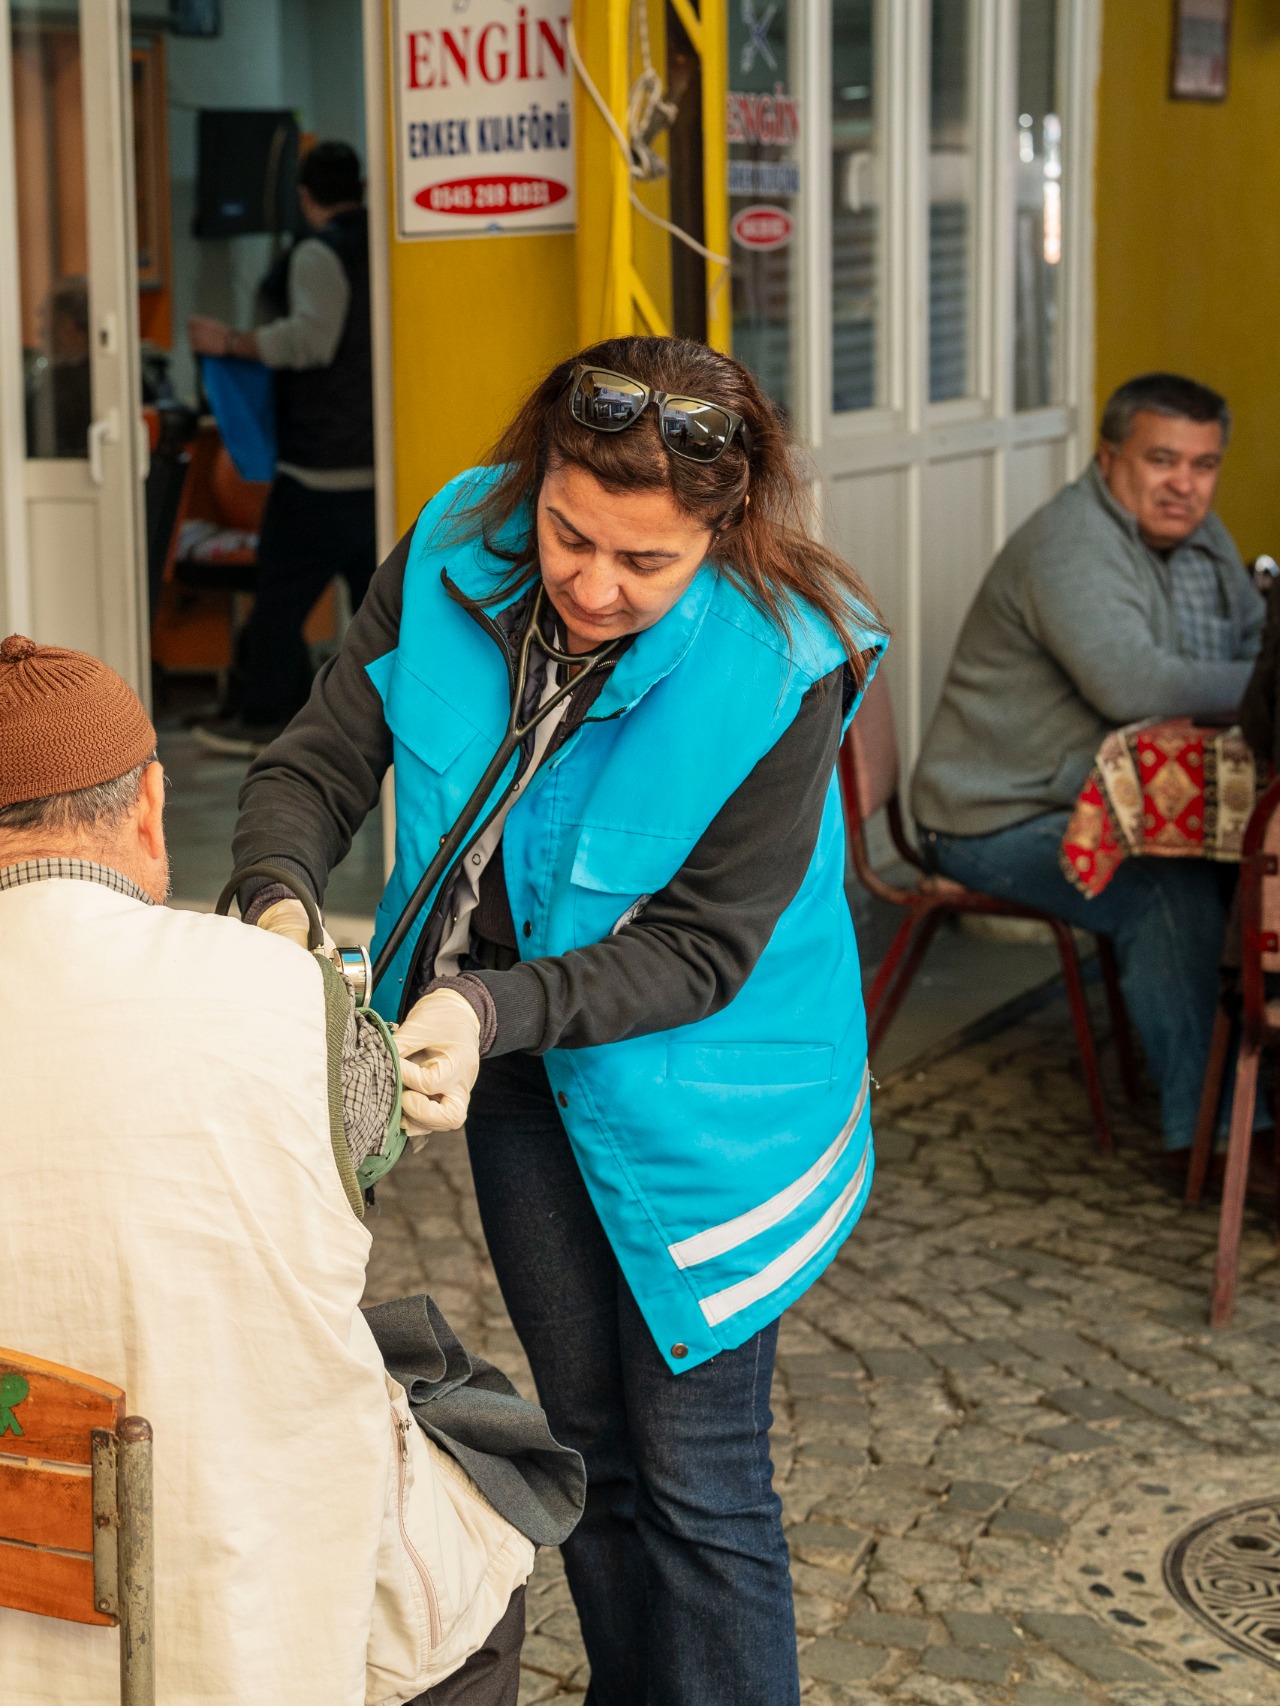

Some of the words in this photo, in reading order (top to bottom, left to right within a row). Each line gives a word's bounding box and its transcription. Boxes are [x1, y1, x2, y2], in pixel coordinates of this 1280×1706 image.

[406, 6, 570, 91] ENGİN
[409, 119, 470, 158] ERKEK
[477, 101, 570, 154] KUAFÖRÜ
